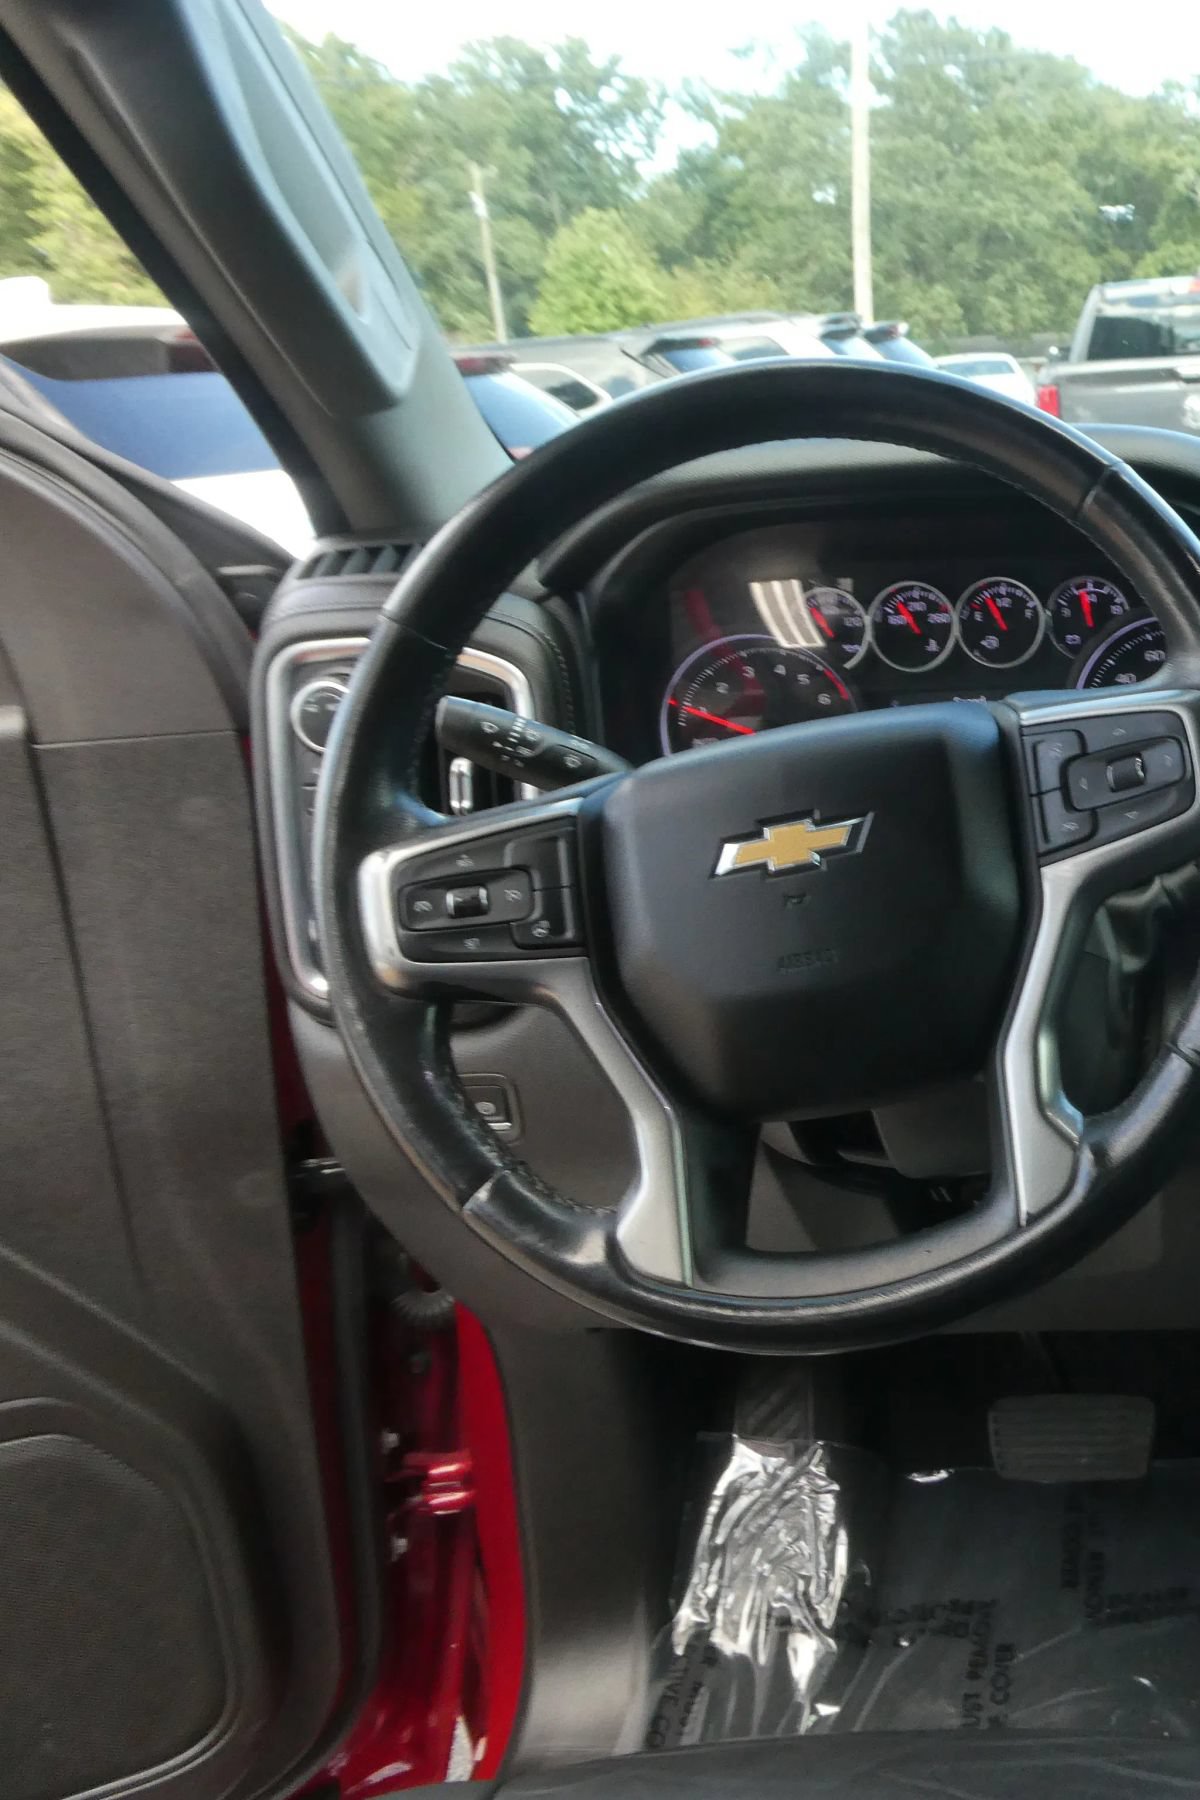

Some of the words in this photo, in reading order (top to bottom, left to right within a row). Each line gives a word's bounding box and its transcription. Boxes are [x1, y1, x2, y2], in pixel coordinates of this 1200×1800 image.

[742, 665, 755, 678] 3
[774, 664, 787, 676] 4
[797, 673, 811, 685] 5
[716, 682, 729, 694] 2
[817, 693, 832, 705] 6
